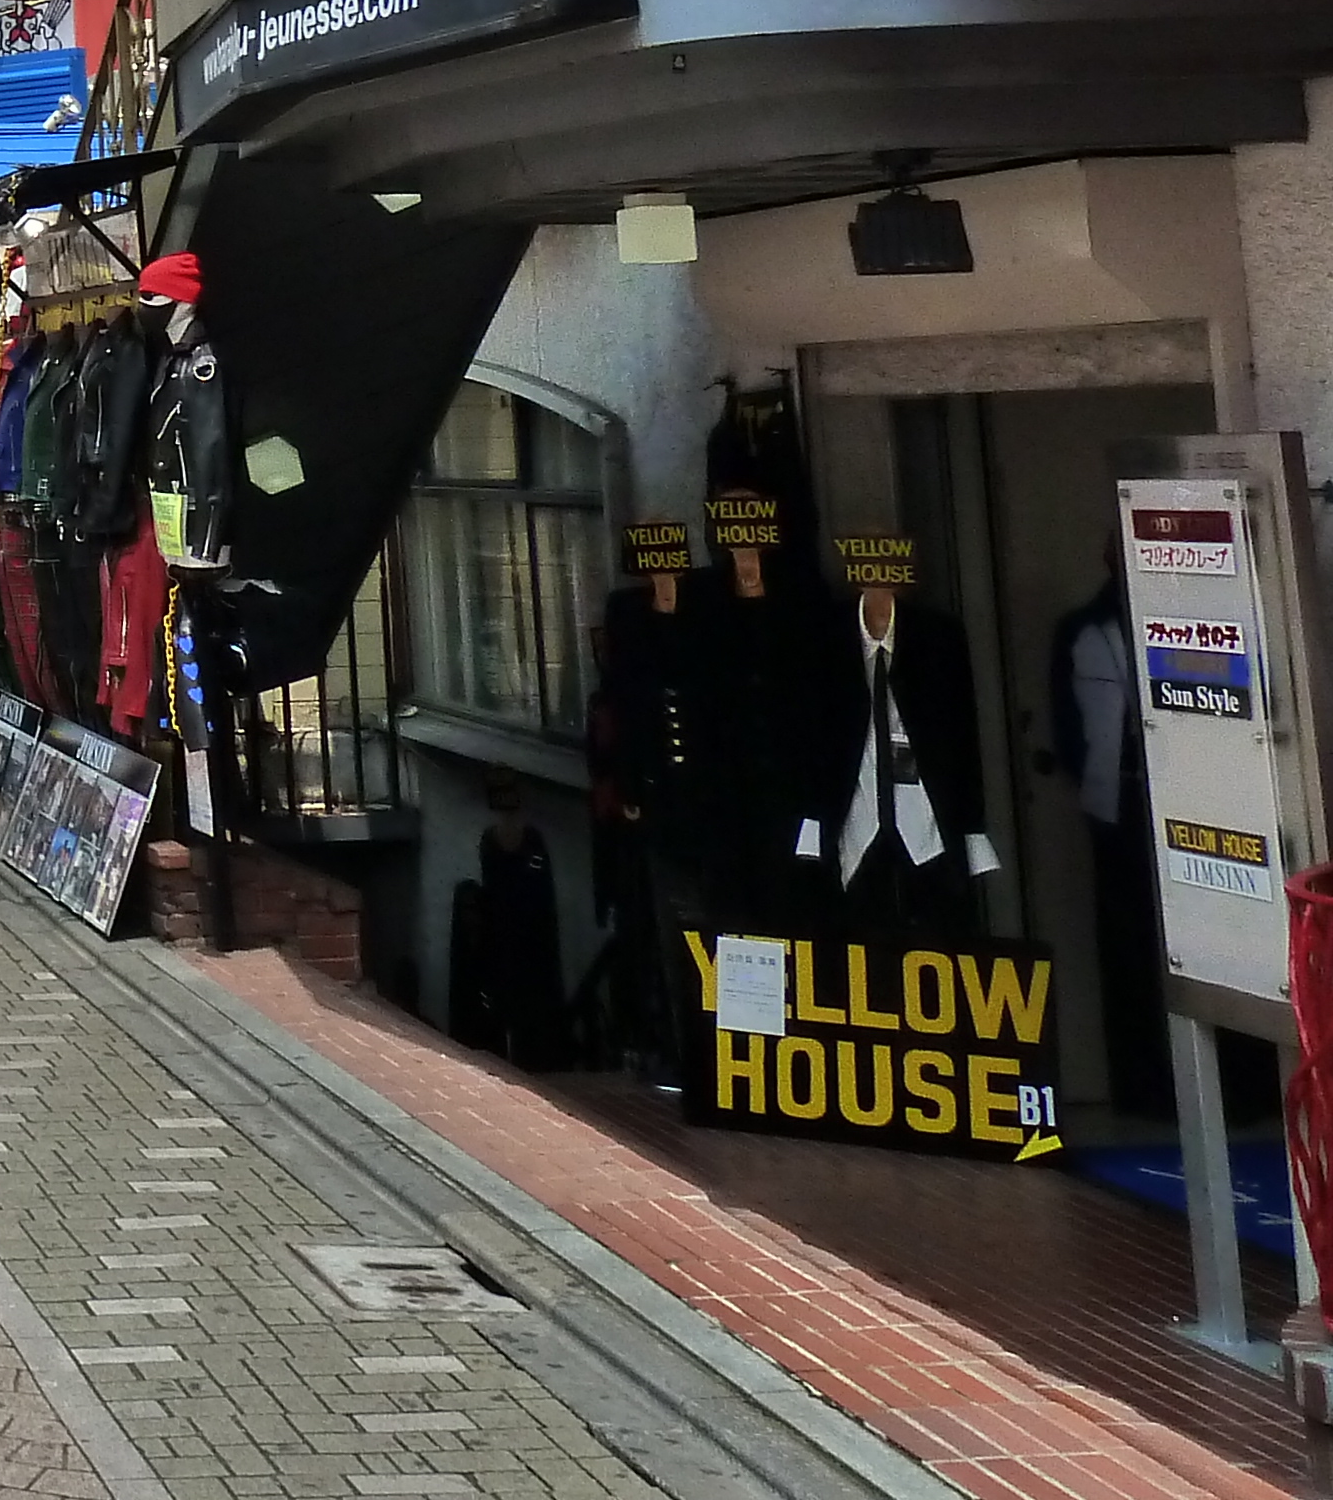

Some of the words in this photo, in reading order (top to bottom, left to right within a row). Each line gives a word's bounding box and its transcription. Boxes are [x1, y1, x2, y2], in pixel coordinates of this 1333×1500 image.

[705, 501, 777, 519] YELLOW
[628, 526, 687, 546] YELLOW
[716, 525, 780, 544] HOUSE
[835, 538, 913, 558] YELLOW
[637, 550, 690, 570] HOUSE
[846, 564, 917, 584] HOUSE
[1196, 623, 1240, 649] 竹の子
[1161, 681, 1194, 708] Sun
[1196, 685, 1240, 716] Style
[1171, 824, 1217, 854] YELLOW
[1222, 833, 1264, 863] HOUSE
[717, 1026, 1025, 1145] HOUSE
[1017, 1084, 1057, 1128] B1
